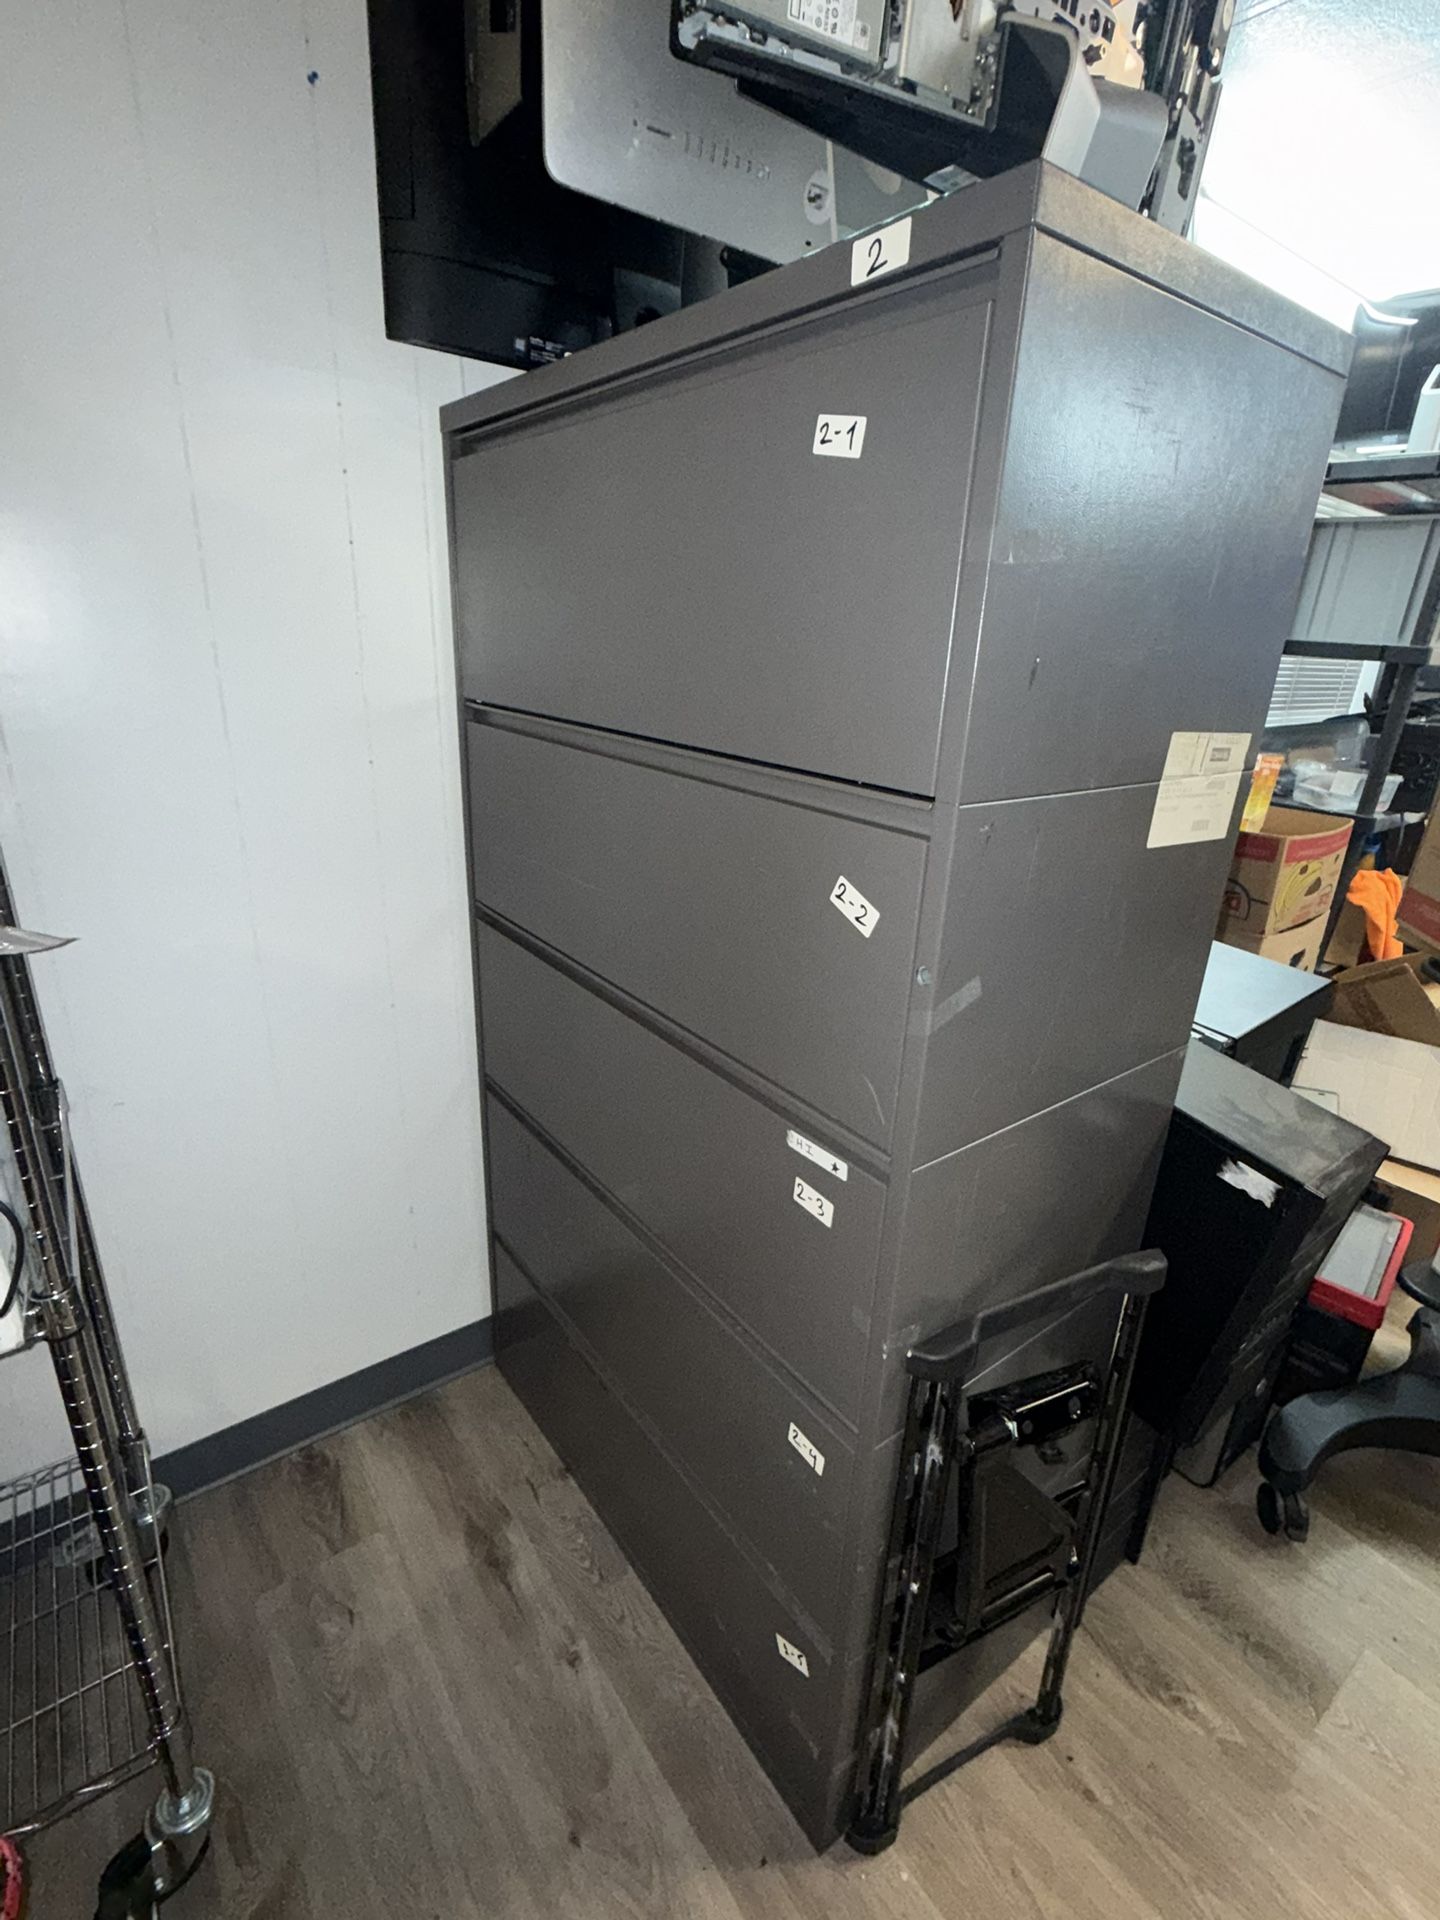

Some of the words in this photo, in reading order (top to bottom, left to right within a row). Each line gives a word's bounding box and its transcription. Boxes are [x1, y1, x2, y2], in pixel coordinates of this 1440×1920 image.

[866, 238, 888, 277] 2
[819, 420, 858, 451] 2-1
[834, 882, 868, 927] 2-2
[796, 1183, 825, 1217] 2-3
[792, 1428, 817, 1470] 2-4
